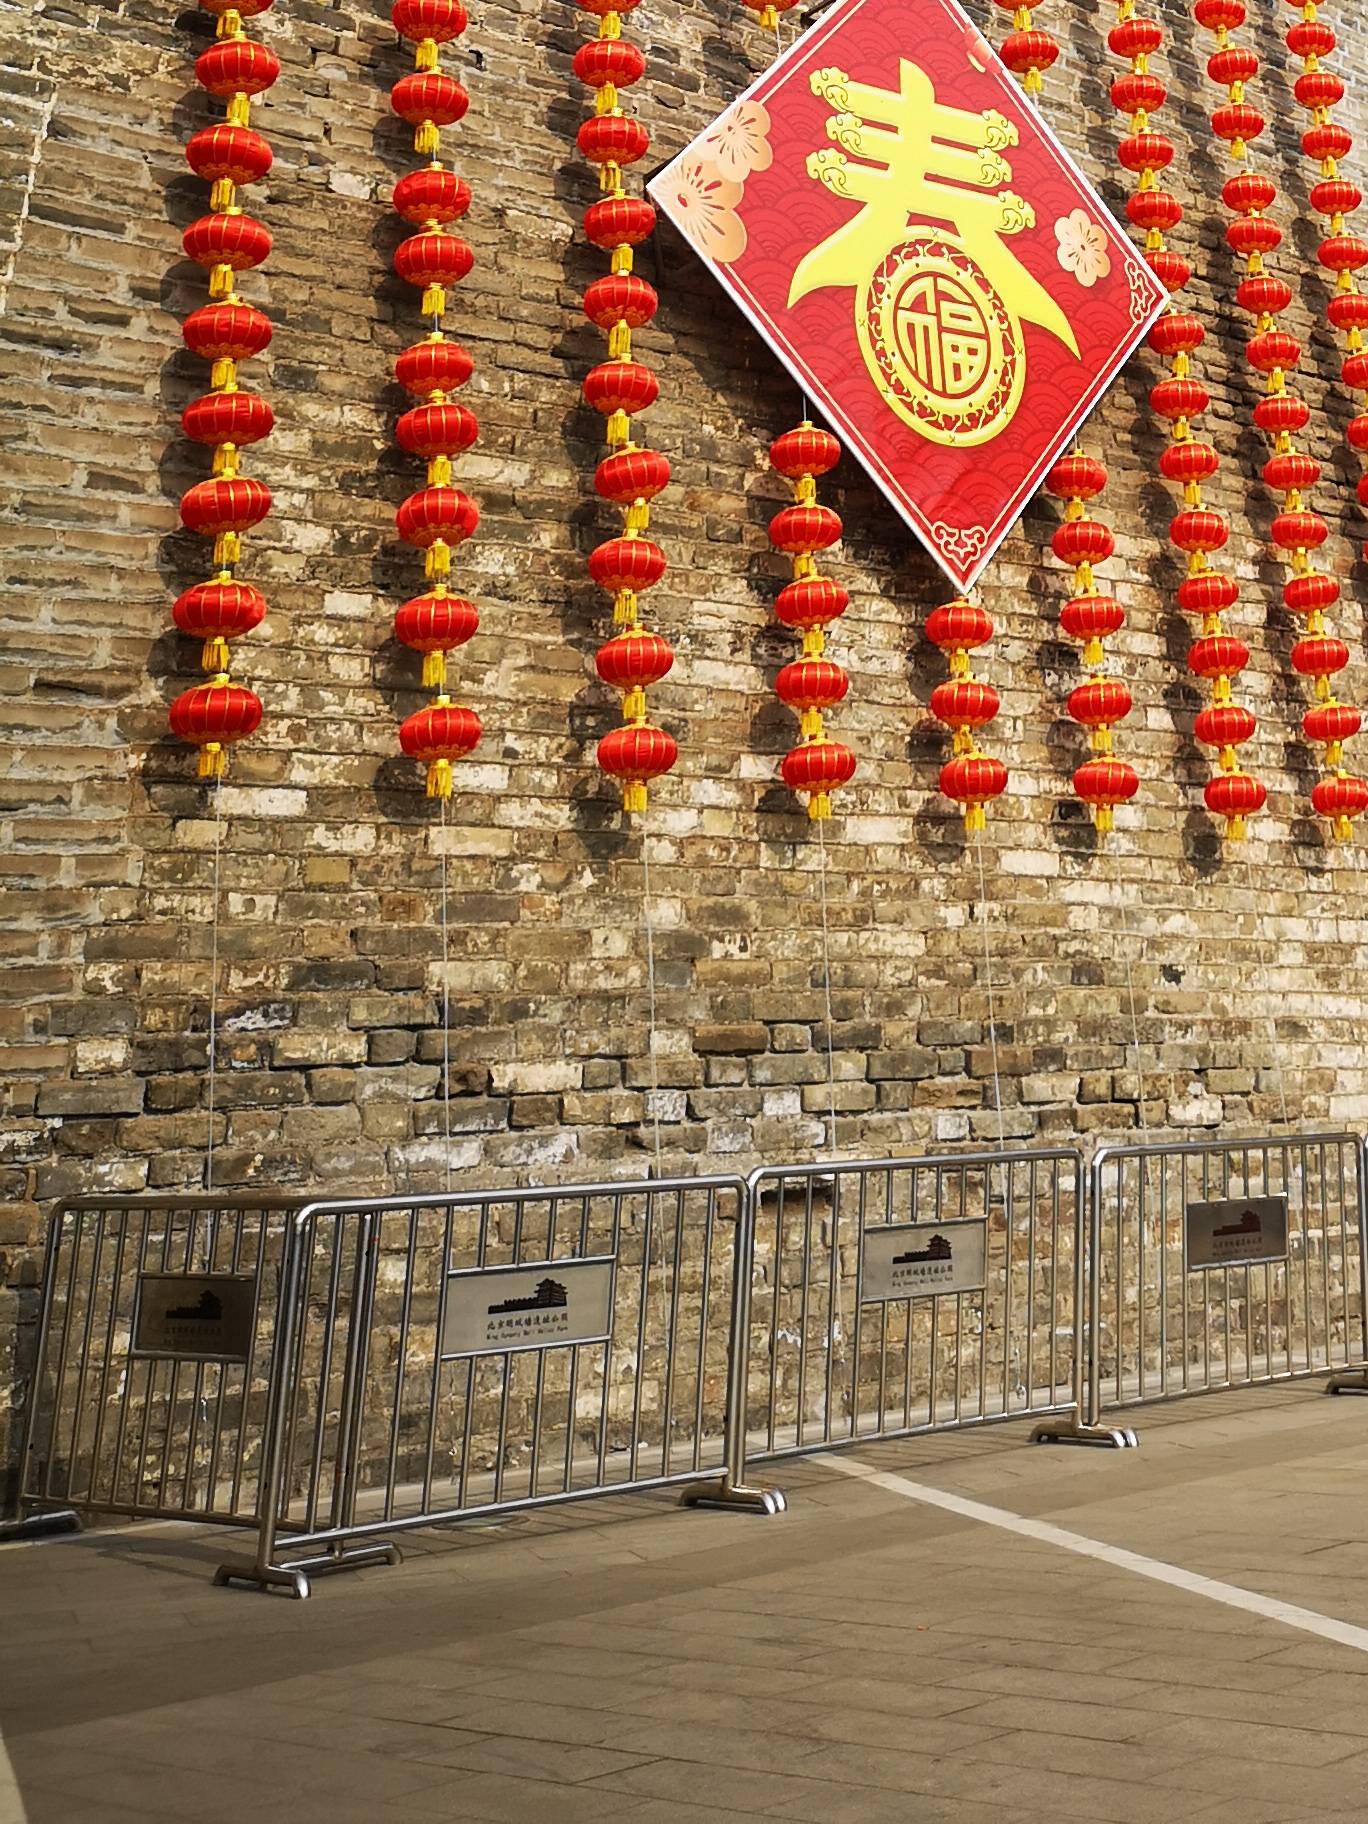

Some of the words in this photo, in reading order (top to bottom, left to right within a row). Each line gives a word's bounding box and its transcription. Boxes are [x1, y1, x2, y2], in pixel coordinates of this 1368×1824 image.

[897, 273, 991, 396] 福
[487, 1312, 568, 1331] 北京明城墙遗址公园
